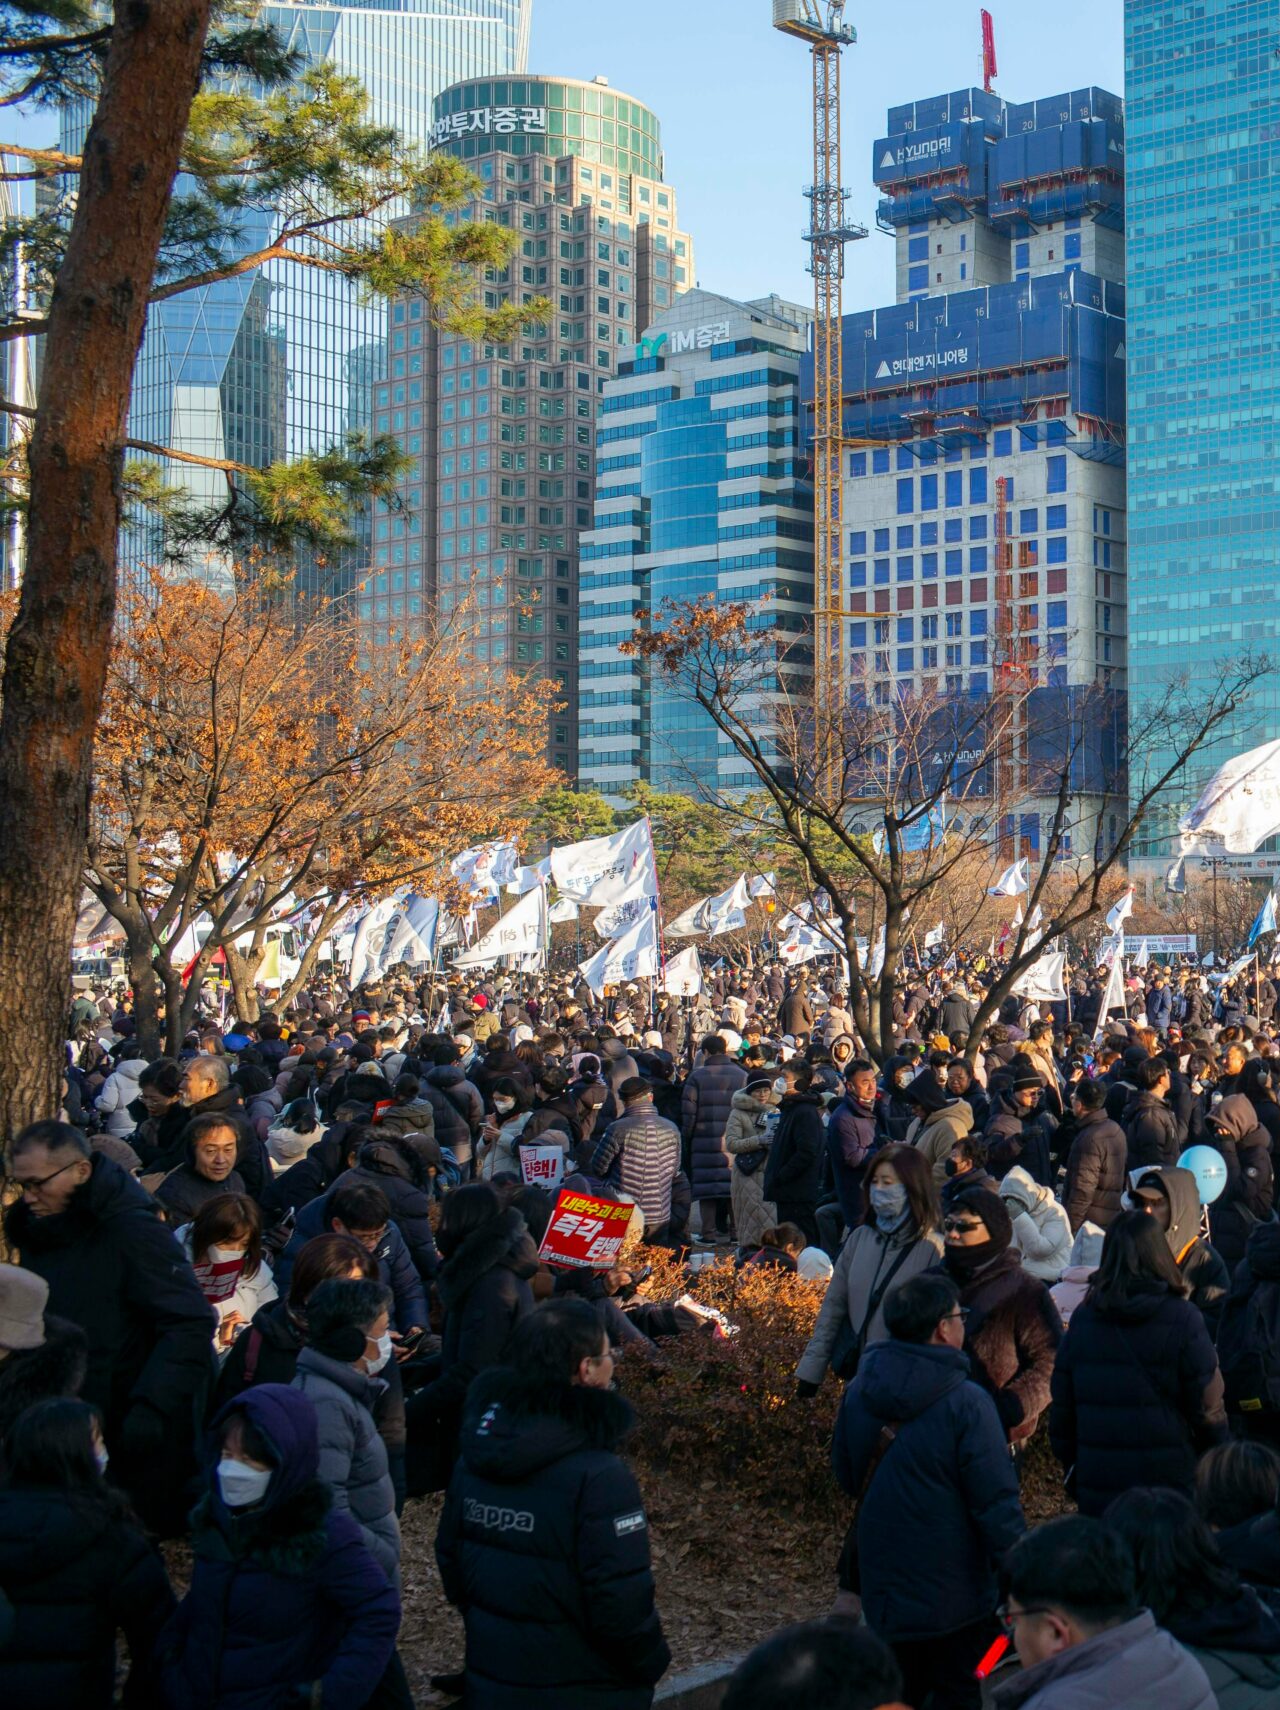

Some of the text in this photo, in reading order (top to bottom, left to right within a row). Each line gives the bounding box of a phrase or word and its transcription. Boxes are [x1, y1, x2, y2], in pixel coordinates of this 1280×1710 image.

[963, 106, 968, 116] 8
[1080, 107, 1089, 117] 18
[941, 112, 947, 122] 9
[1060, 112, 1069, 122] 19
[904, 121, 913, 131] 10
[1023, 120, 1033, 131] 20
[897, 136, 951, 160] HYUNDAI
[975, 307, 984, 317] 16
[905, 321, 914, 331] 18
[671, 321, 730, 353] iM증권
[864, 329, 873, 339] 19
[892, 348, 968, 375] 현대엔지니어링
[525, 1159, 557, 1182] 탄핵!
[560, 1196, 614, 1219] 내란수괴
[552, 1213, 604, 1242] 즉각
[585, 1236, 624, 1258] 탄핵
[464, 1497, 535, 1532] Kappa
